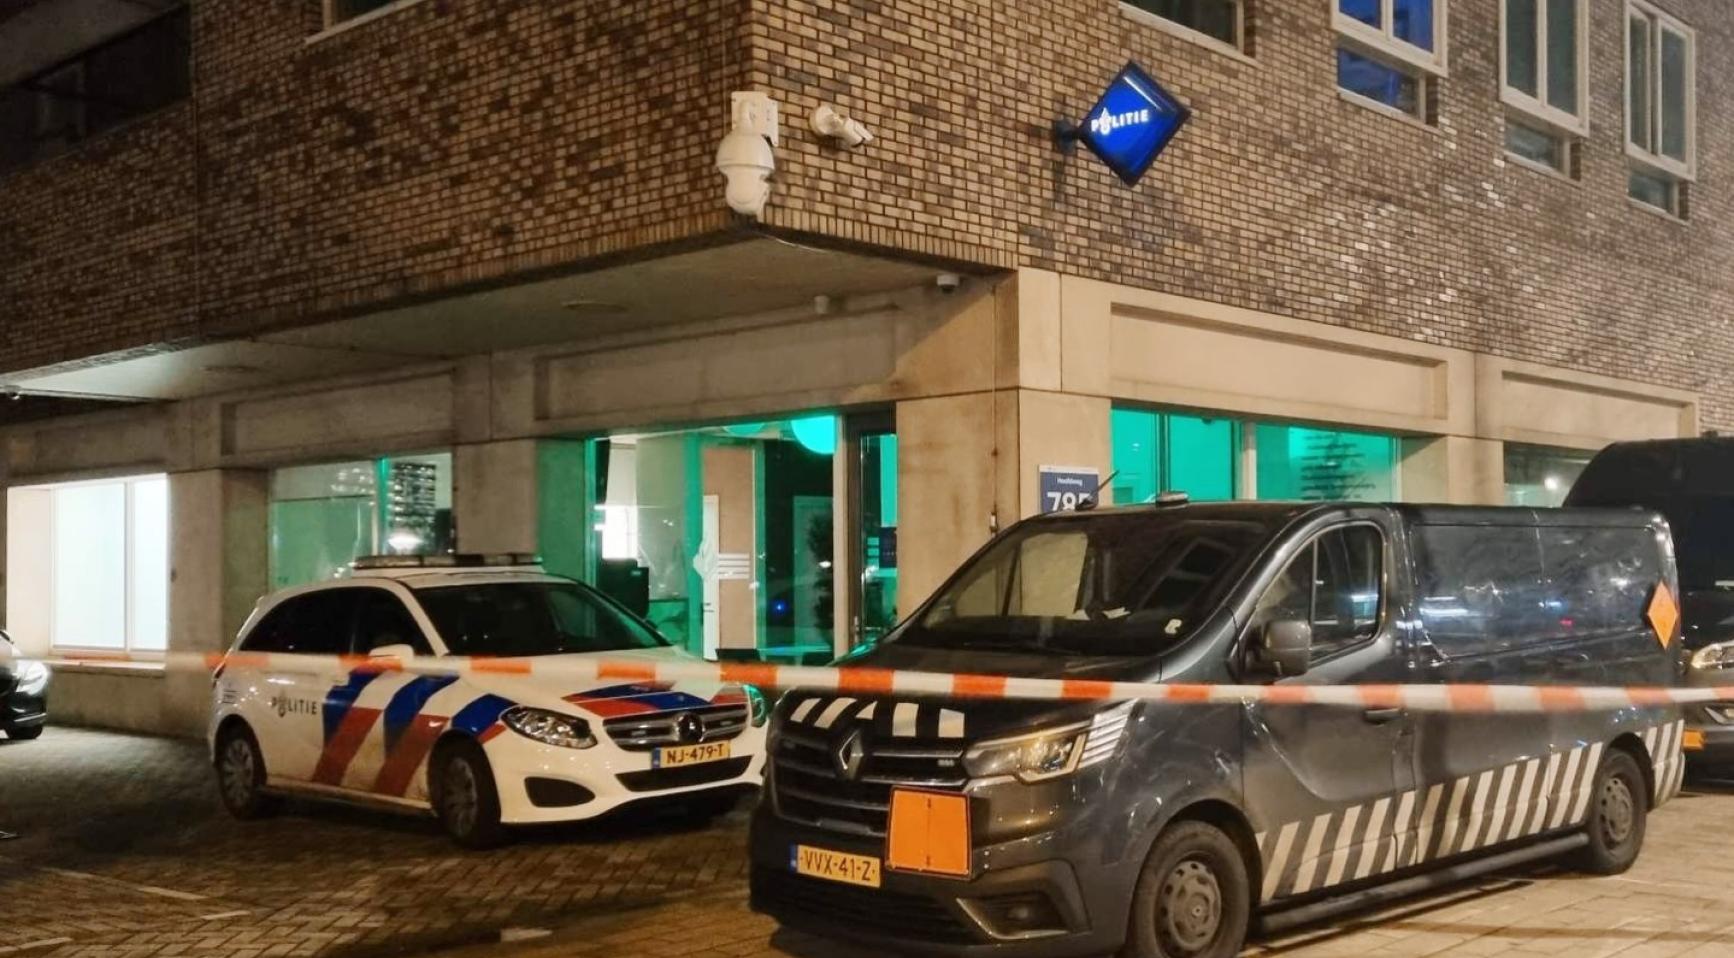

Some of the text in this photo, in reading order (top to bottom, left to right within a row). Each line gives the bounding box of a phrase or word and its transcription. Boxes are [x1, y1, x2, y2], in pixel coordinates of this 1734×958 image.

[1091, 107, 1149, 135] POLITIE
[271, 691, 317, 717] POLITIE
[667, 743, 724, 764] NJ-479-T
[804, 850, 871, 881] VVX-41-Z
